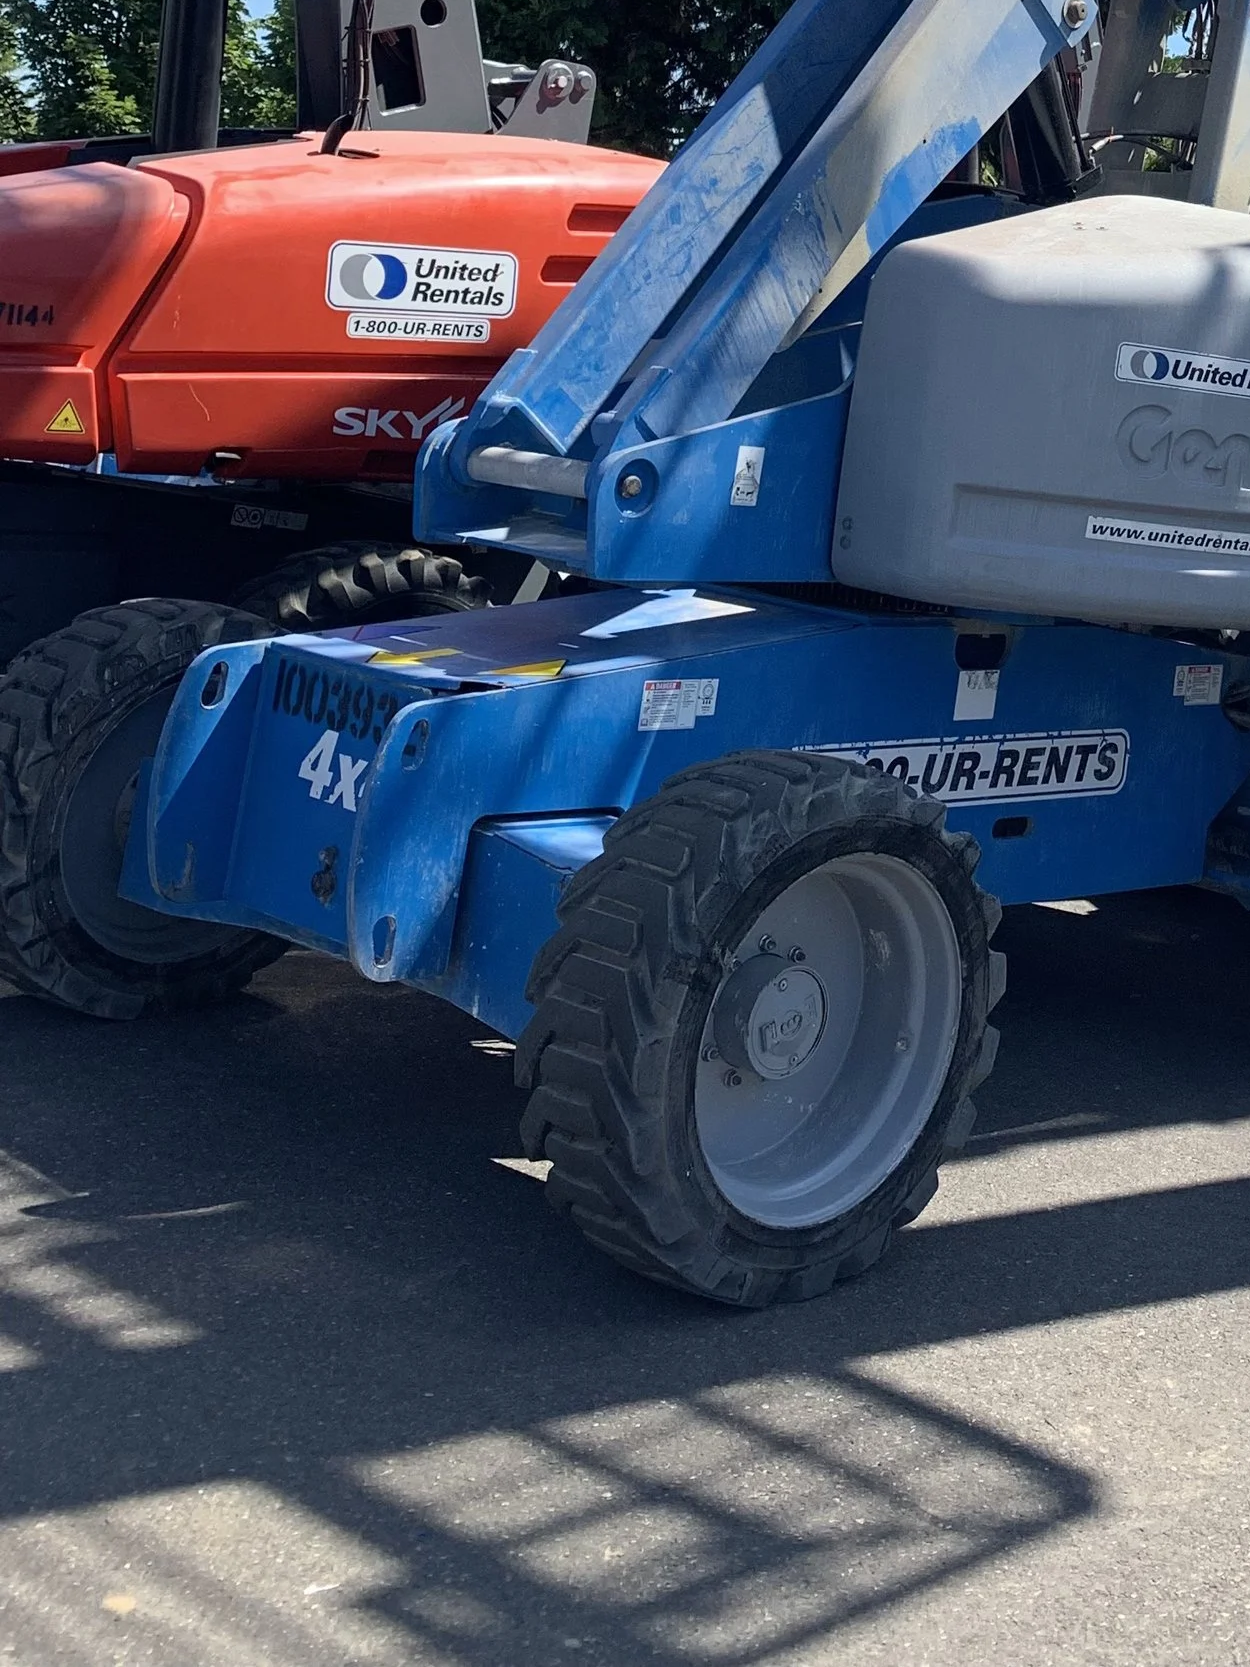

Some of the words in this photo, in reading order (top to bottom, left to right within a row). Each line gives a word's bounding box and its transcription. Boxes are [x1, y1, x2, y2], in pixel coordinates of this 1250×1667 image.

[415, 258, 504, 283] United
[411, 282, 505, 306] Rentals
[353, 320, 484, 338] 1-800-UR-RENTS
[1170, 359, 1247, 390] United
